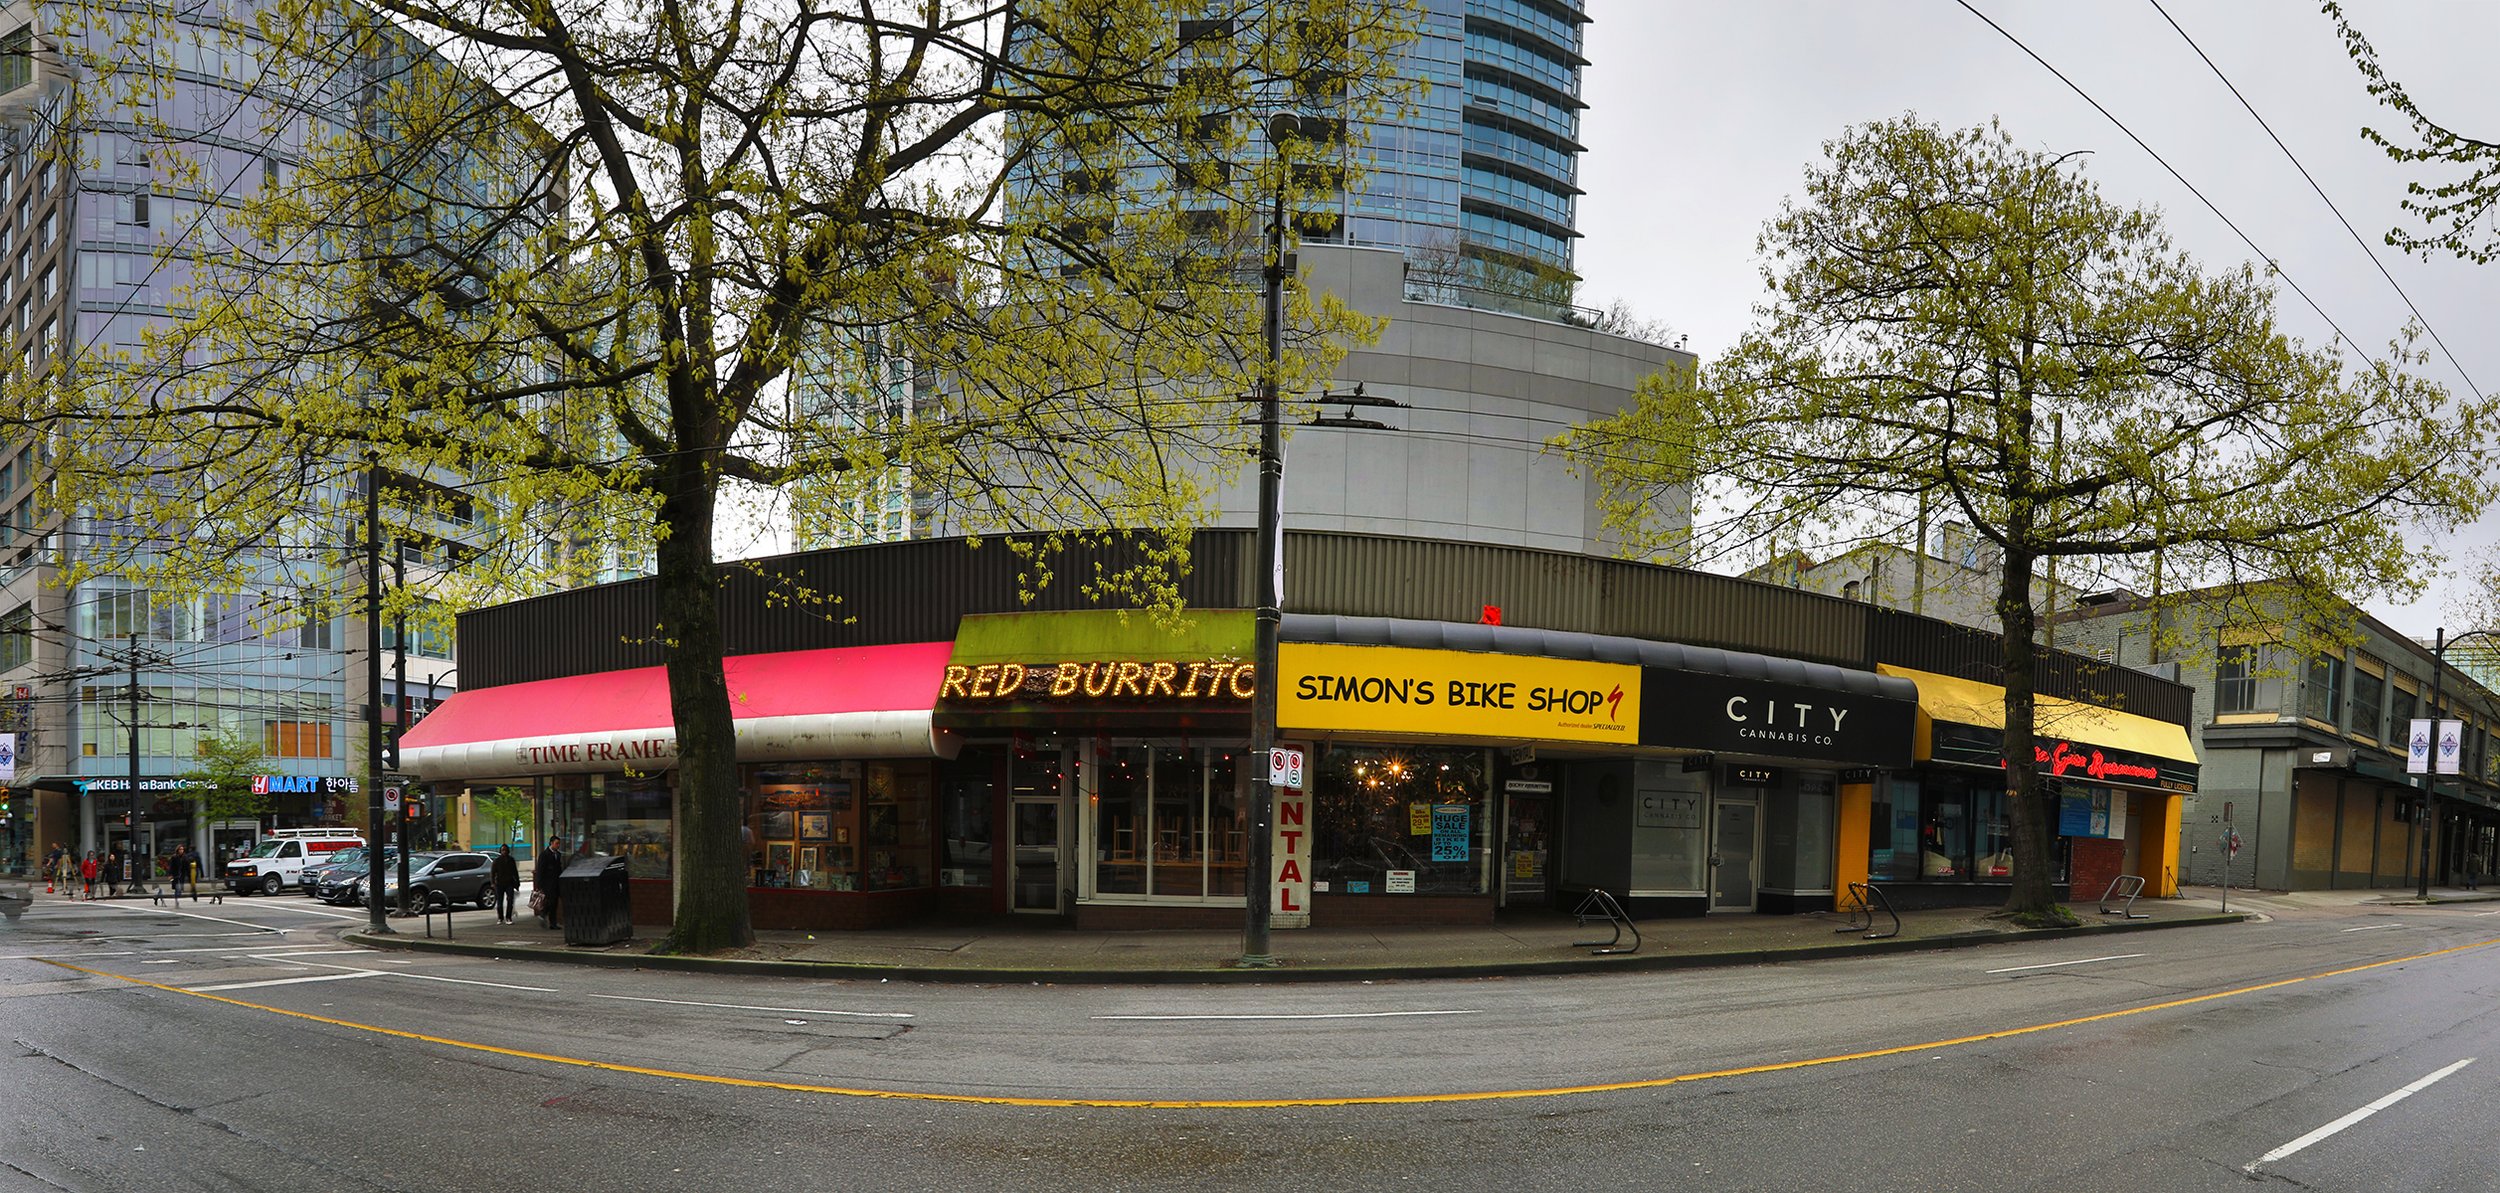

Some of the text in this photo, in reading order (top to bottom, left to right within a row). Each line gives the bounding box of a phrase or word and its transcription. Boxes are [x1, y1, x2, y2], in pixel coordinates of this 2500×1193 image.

[940, 662, 1025, 698] RED
[1296, 675, 1604, 715] SIMON'S BIKE SHOP
[1726, 696, 1848, 732] CITY
[1593, 723, 1626, 731] SPECIALIZED
[1740, 728, 1833, 745] CANNABIS CO.
[529, 739, 667, 765] TIME FRAME
[1740, 770, 1770, 779] CITY
[1845, 769, 1872, 779] CITY
[97, 779, 118, 790] KEB
[150, 779, 176, 790] Bank
[269, 775, 319, 793] MART
[325, 776, 359, 793] 한아름
[2160, 780, 2194, 792] FULLY LICENSED
[1644, 797, 1696, 811] CITY
[1435, 822, 1466, 830] SALE
[1434, 845, 1466, 856] 25%
